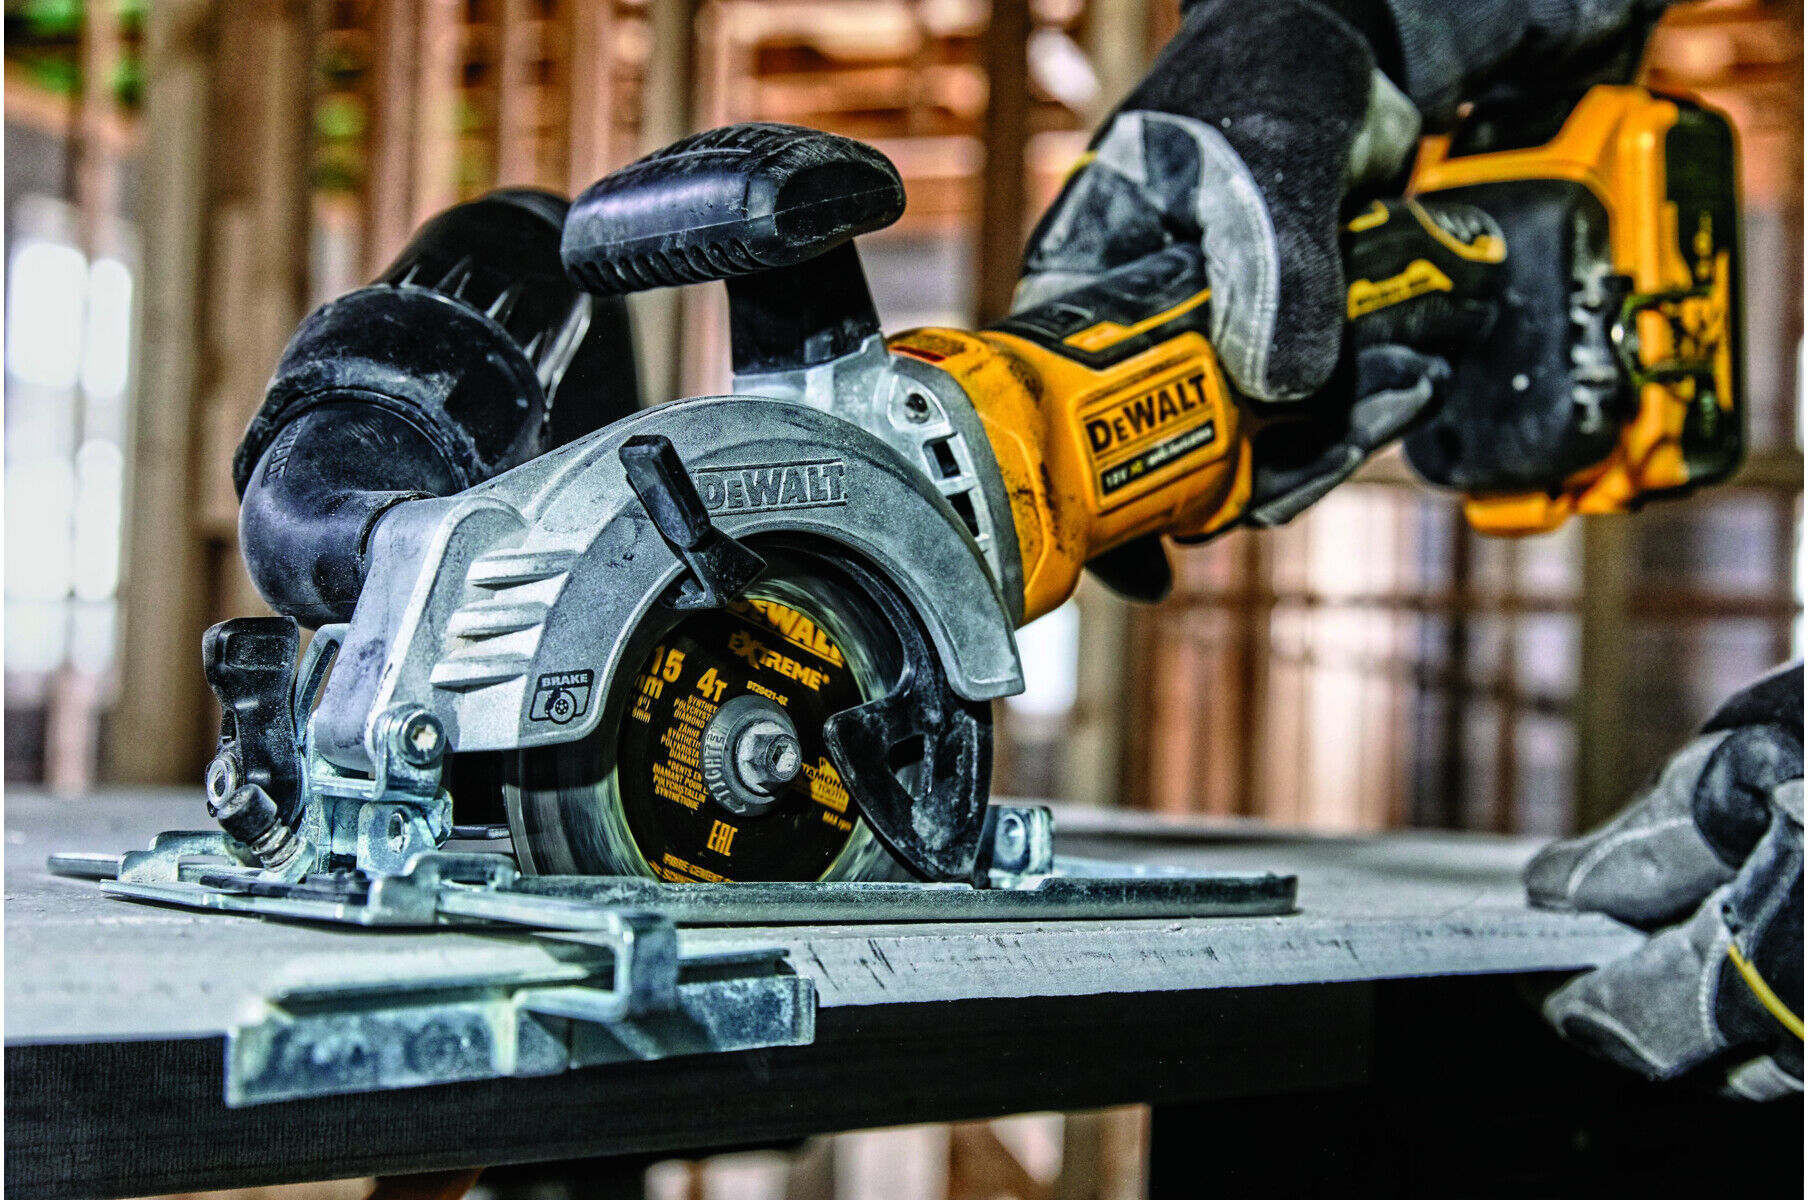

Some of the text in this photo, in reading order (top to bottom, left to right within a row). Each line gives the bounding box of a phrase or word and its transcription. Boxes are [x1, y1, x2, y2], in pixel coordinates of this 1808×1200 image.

[1086, 374, 1206, 453] DEWALT
[696, 462, 846, 511] DEWALT
[541, 672, 589, 688] BRAKE
[728, 631, 822, 692] EXTREME
